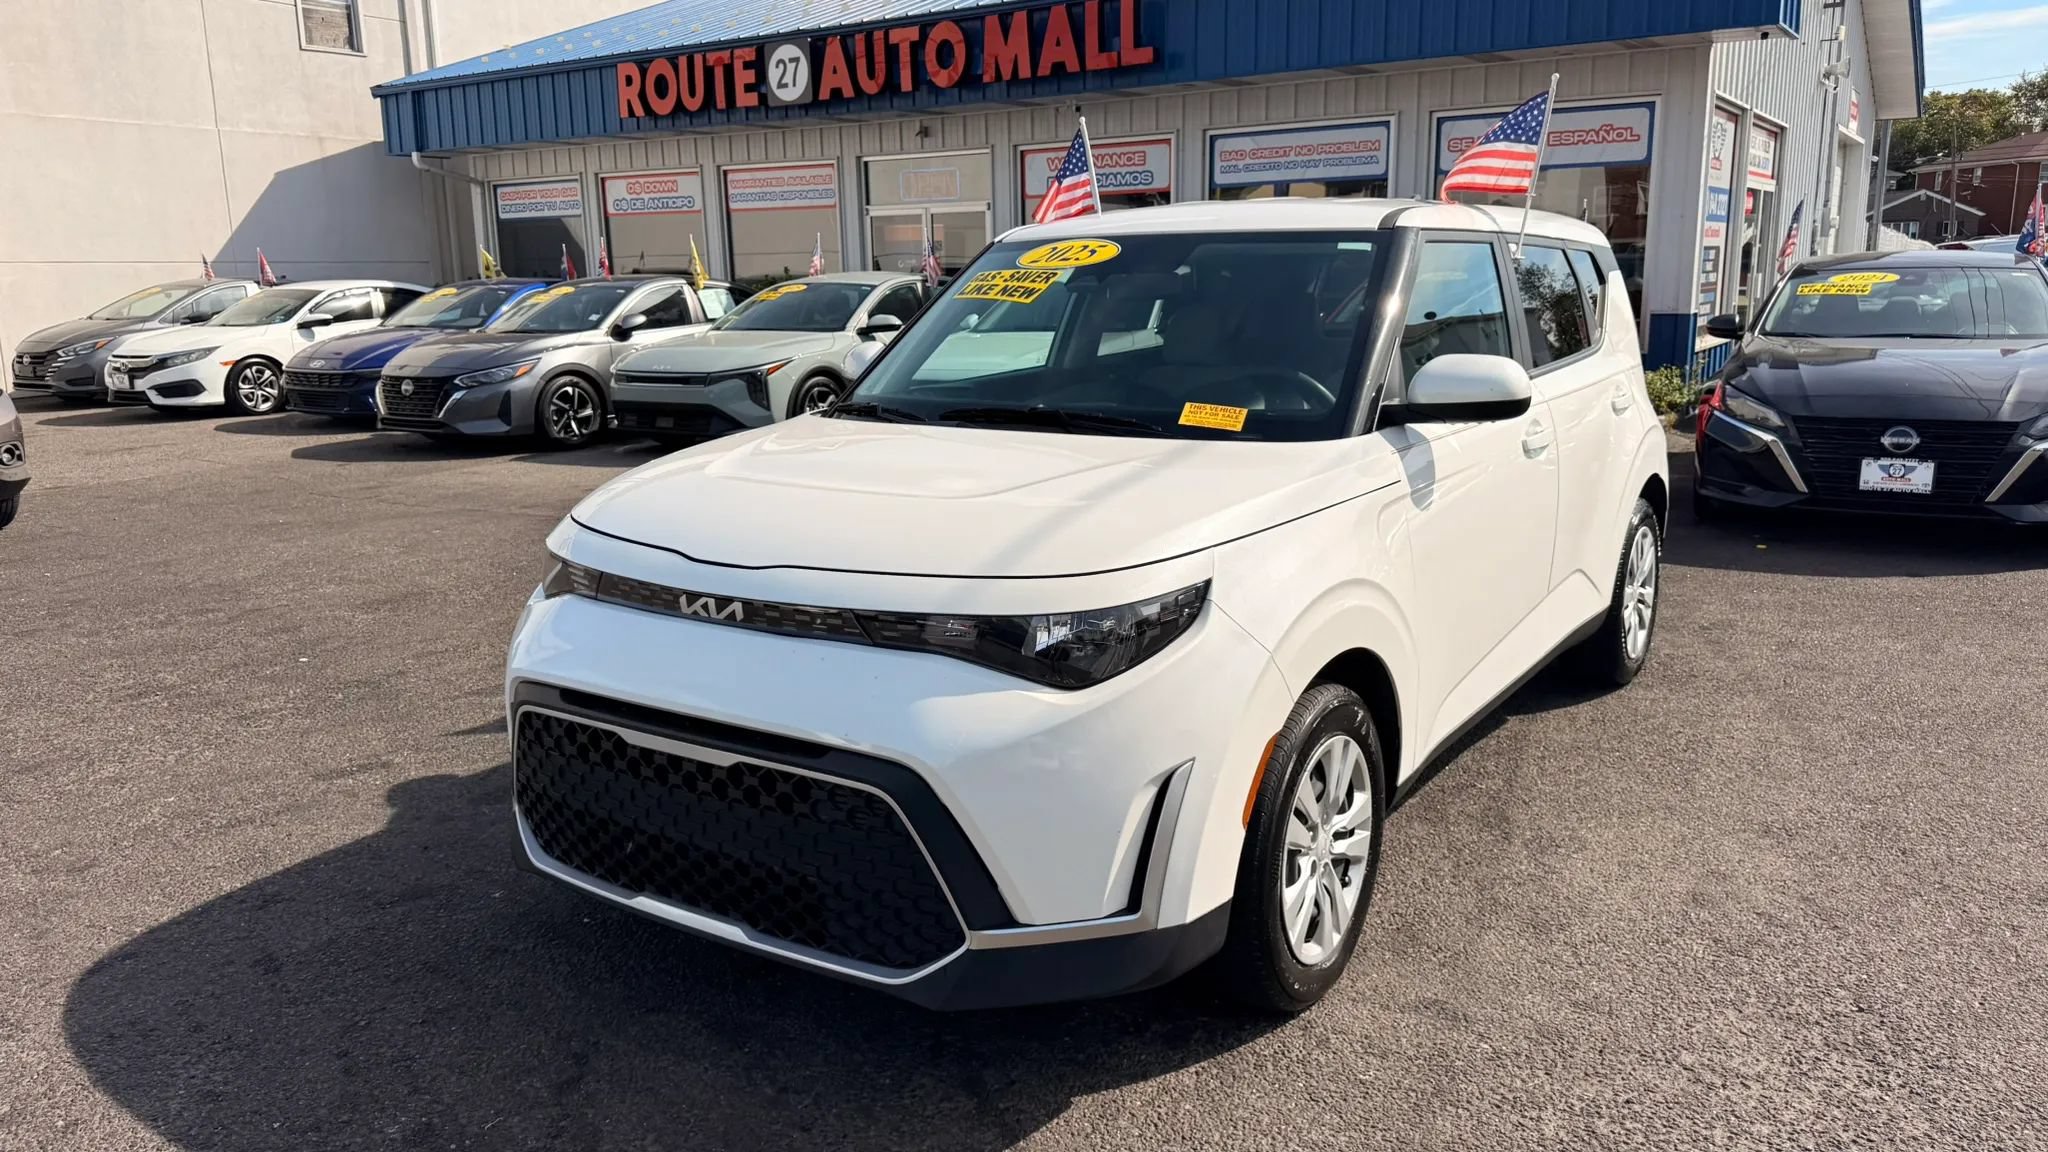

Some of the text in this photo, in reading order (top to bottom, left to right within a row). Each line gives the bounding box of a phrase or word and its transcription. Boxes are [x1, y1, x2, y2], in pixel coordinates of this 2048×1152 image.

[617, 0, 1154, 118] ROUTE 27 AUTO MALL
[1548, 124, 1640, 147] ESPAÑOL
[1220, 139, 1381, 161] BAD CREDIT NO PROBLEM
[1093, 151, 1146, 169] NANCE
[1220, 155, 1379, 174] MAL CREDITO NO HAY PROBLEMA
[643, 180, 678, 194] DOWN
[730, 174, 832, 189] WARRANTIES AVAILABLE
[520, 190, 537, 200] FOR
[538, 188, 560, 198] YOUR
[561, 187, 578, 198] CAR
[729, 189, 835, 203] GARANTIAS DISPONIBLES
[501, 200, 581, 213] DINERO POR TU AUTO
[630, 198, 645, 210] DE
[646, 196, 695, 209] ANTICIPO
[1027, 244, 1107, 264] 2025
[958, 284, 1042, 300] LIKE NEW
[1210, 405, 1244, 415] VEHICLE
[1892, 467, 1902, 476] 27
[680, 593, 744, 622] KIA
